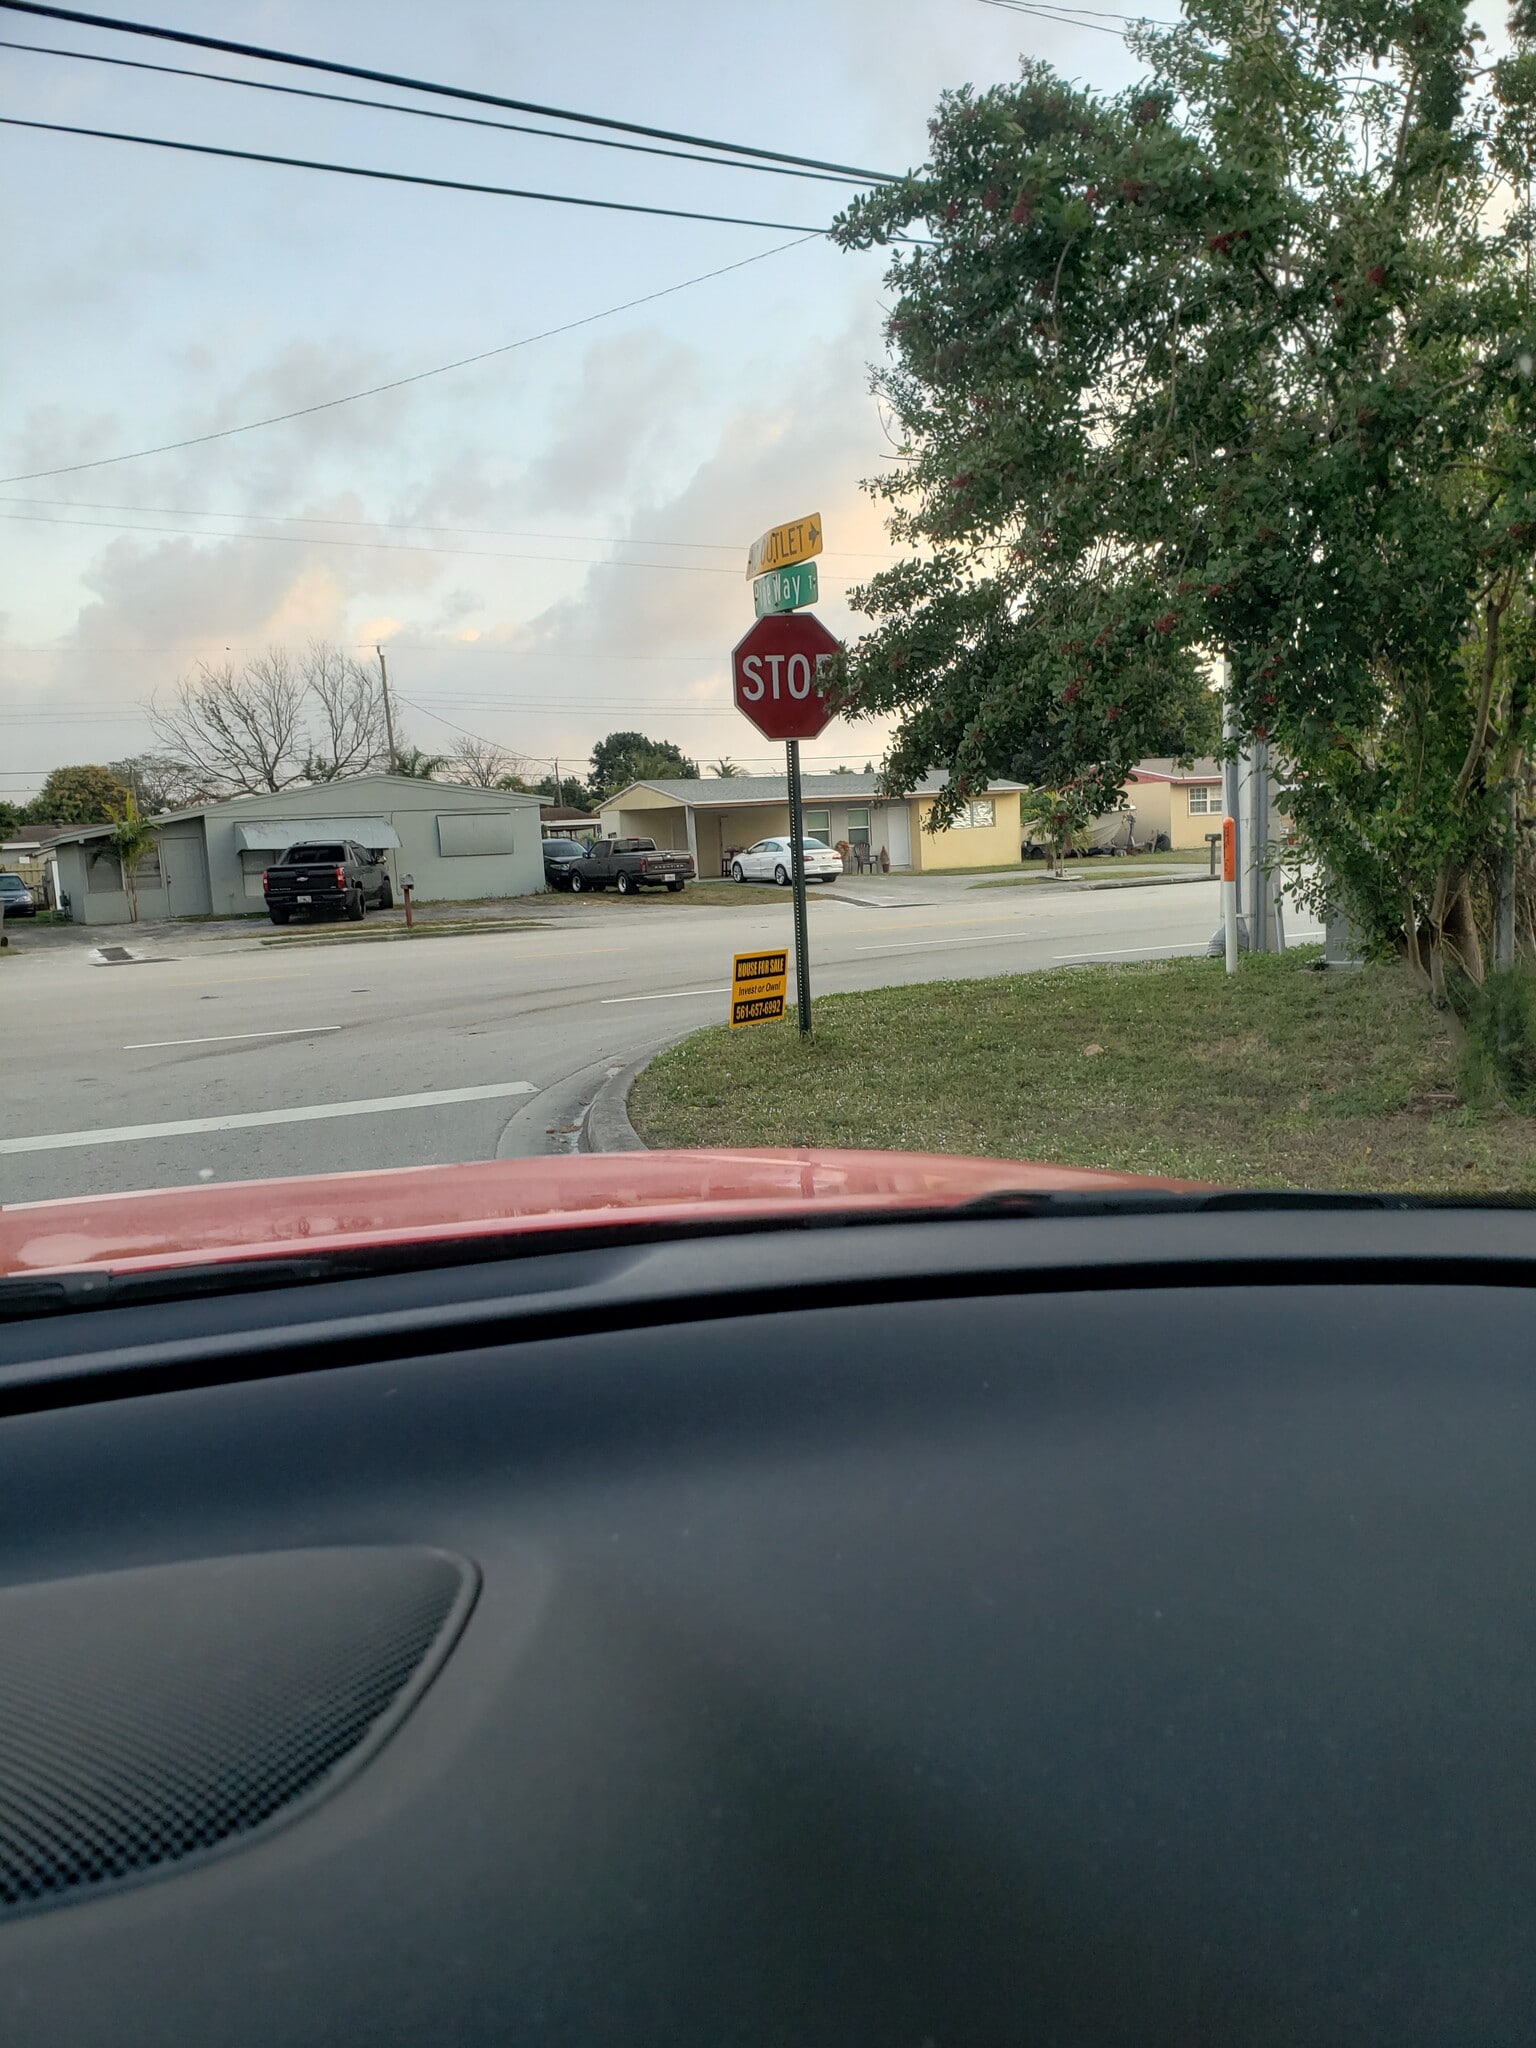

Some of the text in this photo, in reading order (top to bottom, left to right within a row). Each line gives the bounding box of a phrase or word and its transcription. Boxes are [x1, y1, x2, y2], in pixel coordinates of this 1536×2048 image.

[761, 524, 803, 565] OUTLET
[738, 958, 783, 977] HOUSE FOR SALE
[739, 986, 757, 996] Invest
[757, 985, 765, 993] or
